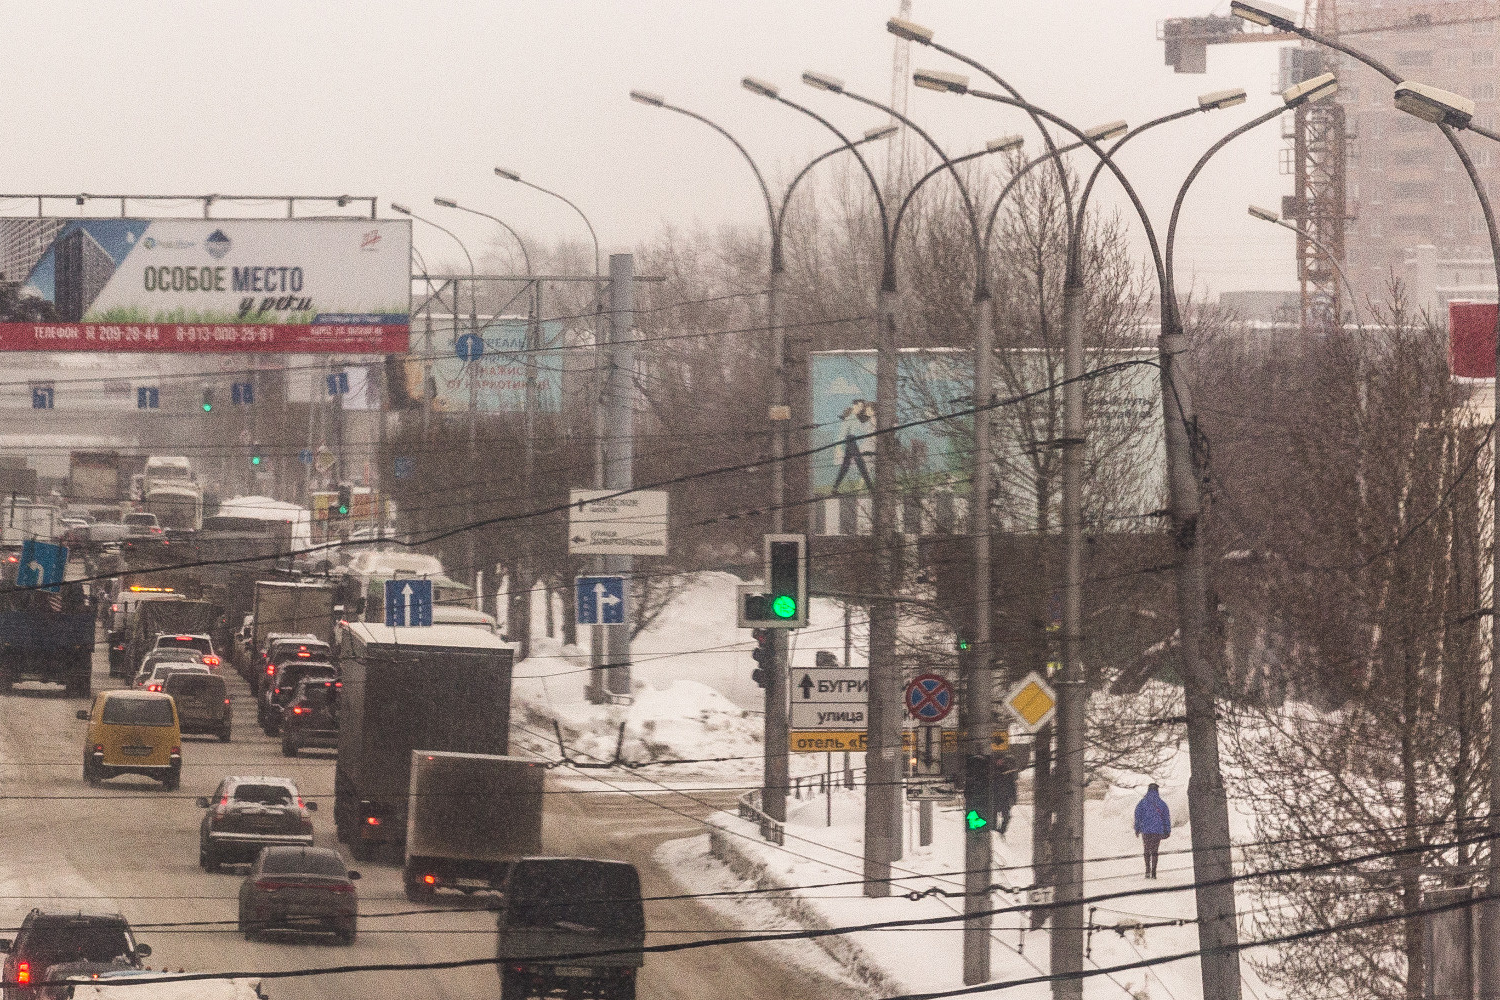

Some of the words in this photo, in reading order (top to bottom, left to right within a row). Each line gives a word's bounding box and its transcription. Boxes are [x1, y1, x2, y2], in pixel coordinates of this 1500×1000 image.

[143, 265, 226, 292] ОСОБОЕ
[232, 266, 304, 292] МЕСТО
[238, 296, 255, 320] у
[256, 295, 315, 319] реки
[33, 326, 80, 339] ТЕЛЕФОН
[817, 710, 864, 726] улица
[797, 736, 845, 749] отель
